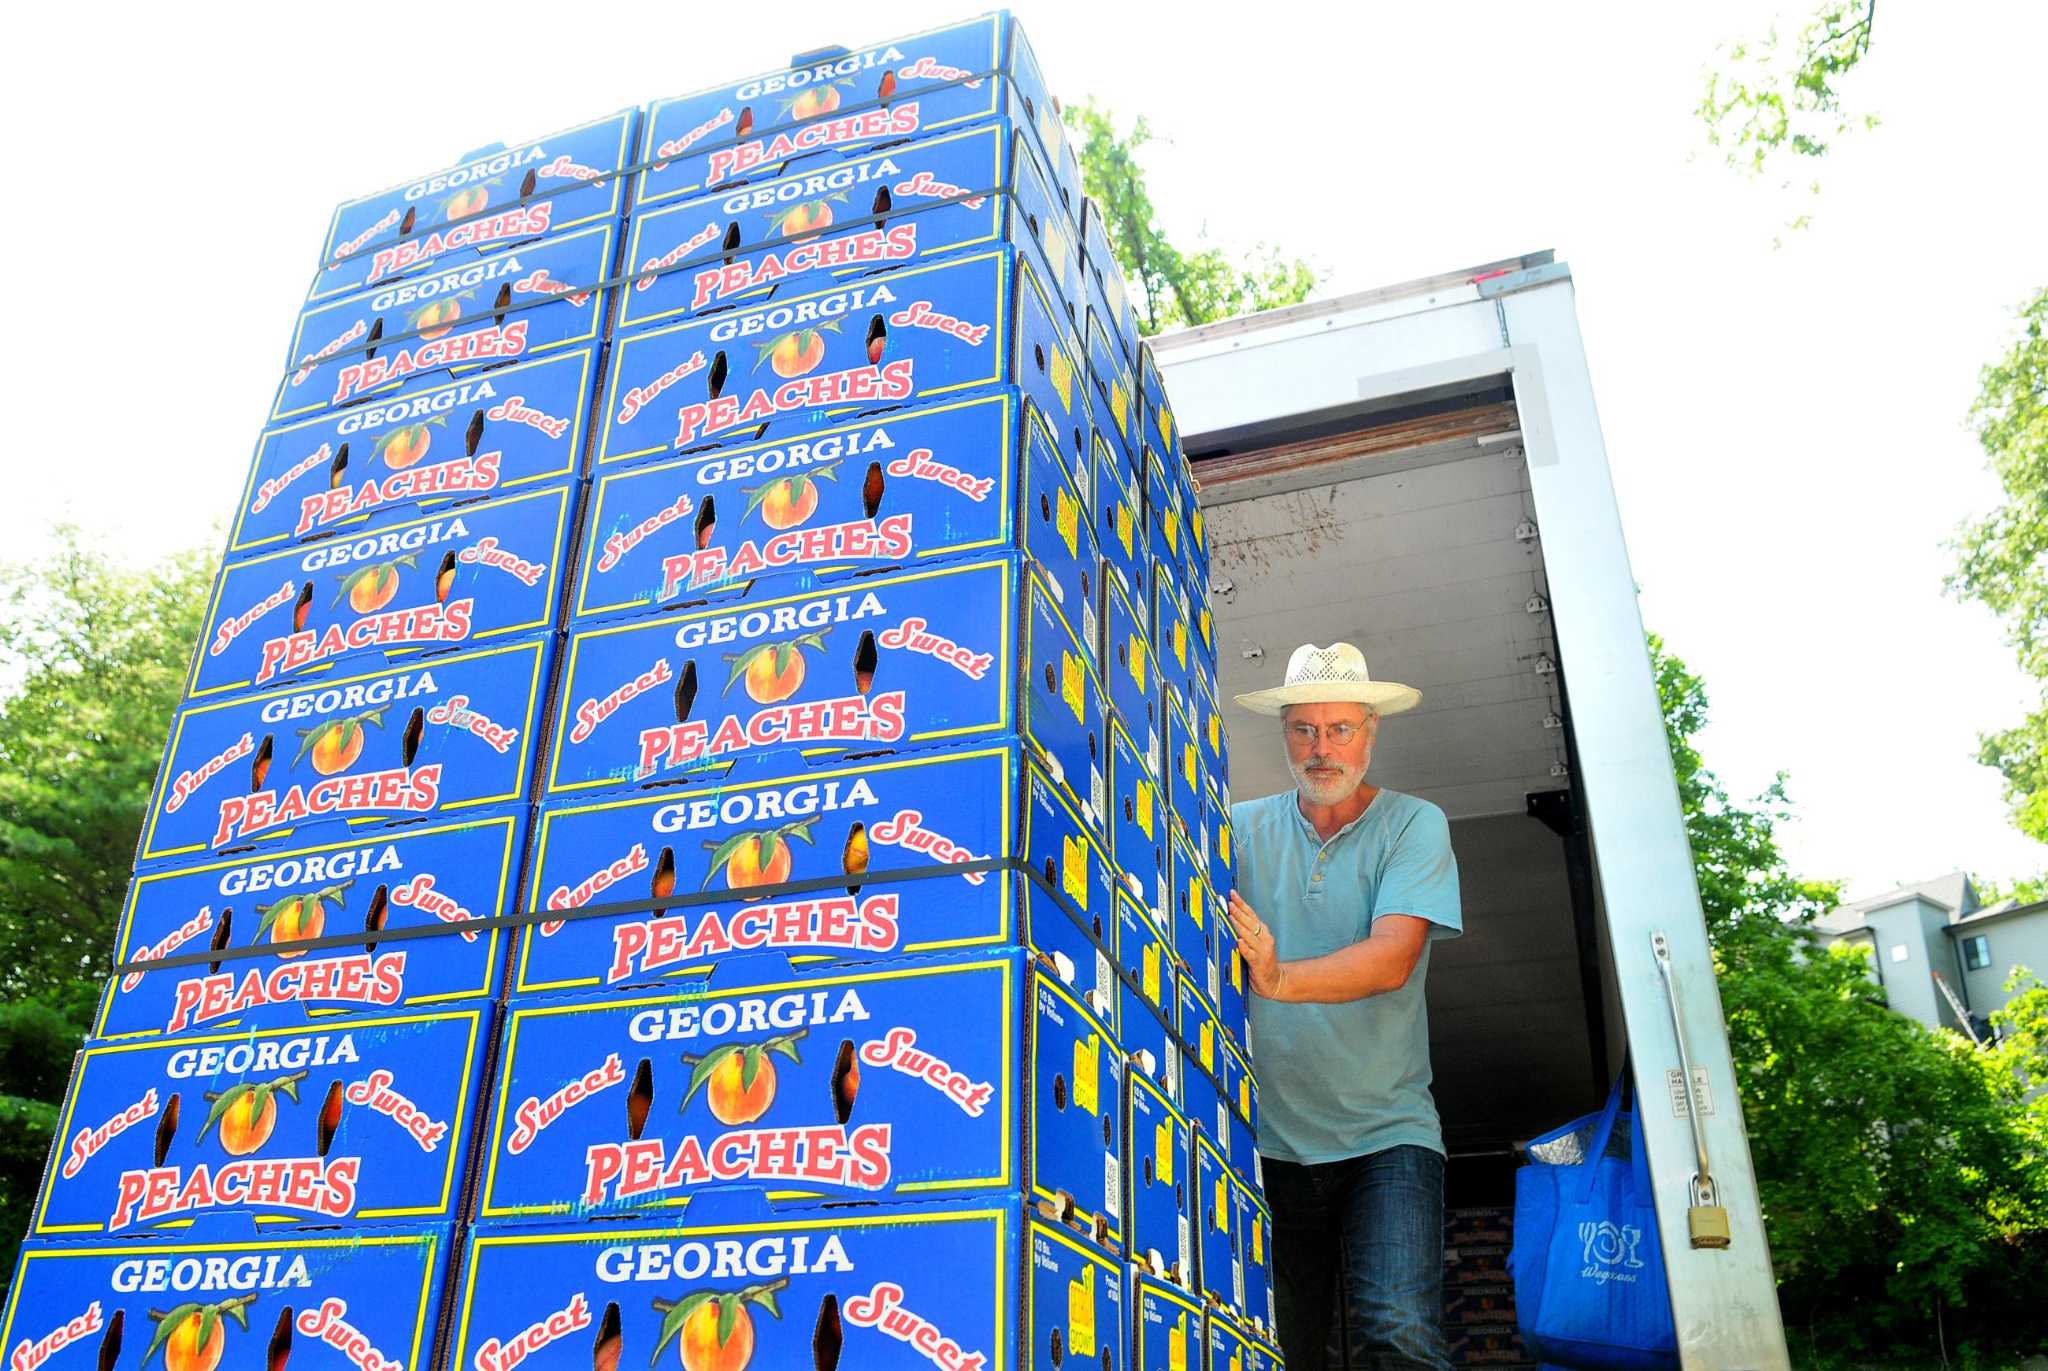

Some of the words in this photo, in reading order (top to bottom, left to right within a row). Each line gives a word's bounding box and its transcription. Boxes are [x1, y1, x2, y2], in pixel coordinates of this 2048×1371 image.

[735, 46, 905, 99] GEORGIA
[403, 144, 547, 202] GEORGIA
[653, 106, 734, 172] Sweet
[705, 101, 919, 189] PEACHES
[722, 159, 901, 216] GEORGIA
[366, 201, 553, 285] PEACHES
[691, 223, 919, 312] PEACHES
[371, 256, 523, 312] GEORGIA
[513, 269, 590, 307] Swet
[710, 285, 896, 347] GEORGIA
[889, 301, 990, 346] Sweet
[331, 319, 530, 405] PEACHES
[617, 351, 707, 424] Sweet
[336, 380, 496, 436] GEORGIA
[486, 396, 570, 439] Sweet
[674, 359, 915, 451] PEACHES
[250, 443, 332, 514] Sweet
[294, 451, 502, 537] PEACHES
[697, 428, 895, 489] GEORGIA
[887, 448, 995, 502] Sweet
[302, 517, 469, 573] GEORGIA
[458, 537, 546, 586] Sweet
[595, 494, 695, 572] Sweet
[657, 511, 912, 603] PEACHES
[210, 580, 295, 656] Sweet
[256, 598, 474, 685] PEACHES
[676, 592, 886, 651] GEORGIA
[878, 617, 994, 680] Sweet
[262, 672, 438, 722] GEORGIA
[426, 695, 519, 753] Sweet
[570, 658, 672, 744] Sweet
[634, 690, 905, 781] PEACHES
[165, 732, 254, 813] Sweet
[212, 764, 442, 849] PEACHES
[653, 779, 878, 835] GEORGIA
[220, 846, 402, 895] GEORGIA
[540, 843, 649, 937] Sweet
[607, 894, 899, 984] PEACHES
[167, 950, 406, 1034] PEACHES
[629, 989, 870, 1043] GEORGIA
[167, 1035, 359, 1079] GEORGIA
[859, 1027, 994, 1117] Sweet
[59, 1088, 159, 1179] Sweet
[346, 1070, 448, 1152] Sweet
[508, 1053, 625, 1154] Sweet
[109, 1157, 361, 1232] PEACHES
[580, 1124, 891, 1205] PEACHES
[112, 1255, 312, 1292] GEORGIA
[596, 1235, 853, 1282] GEORGIA
